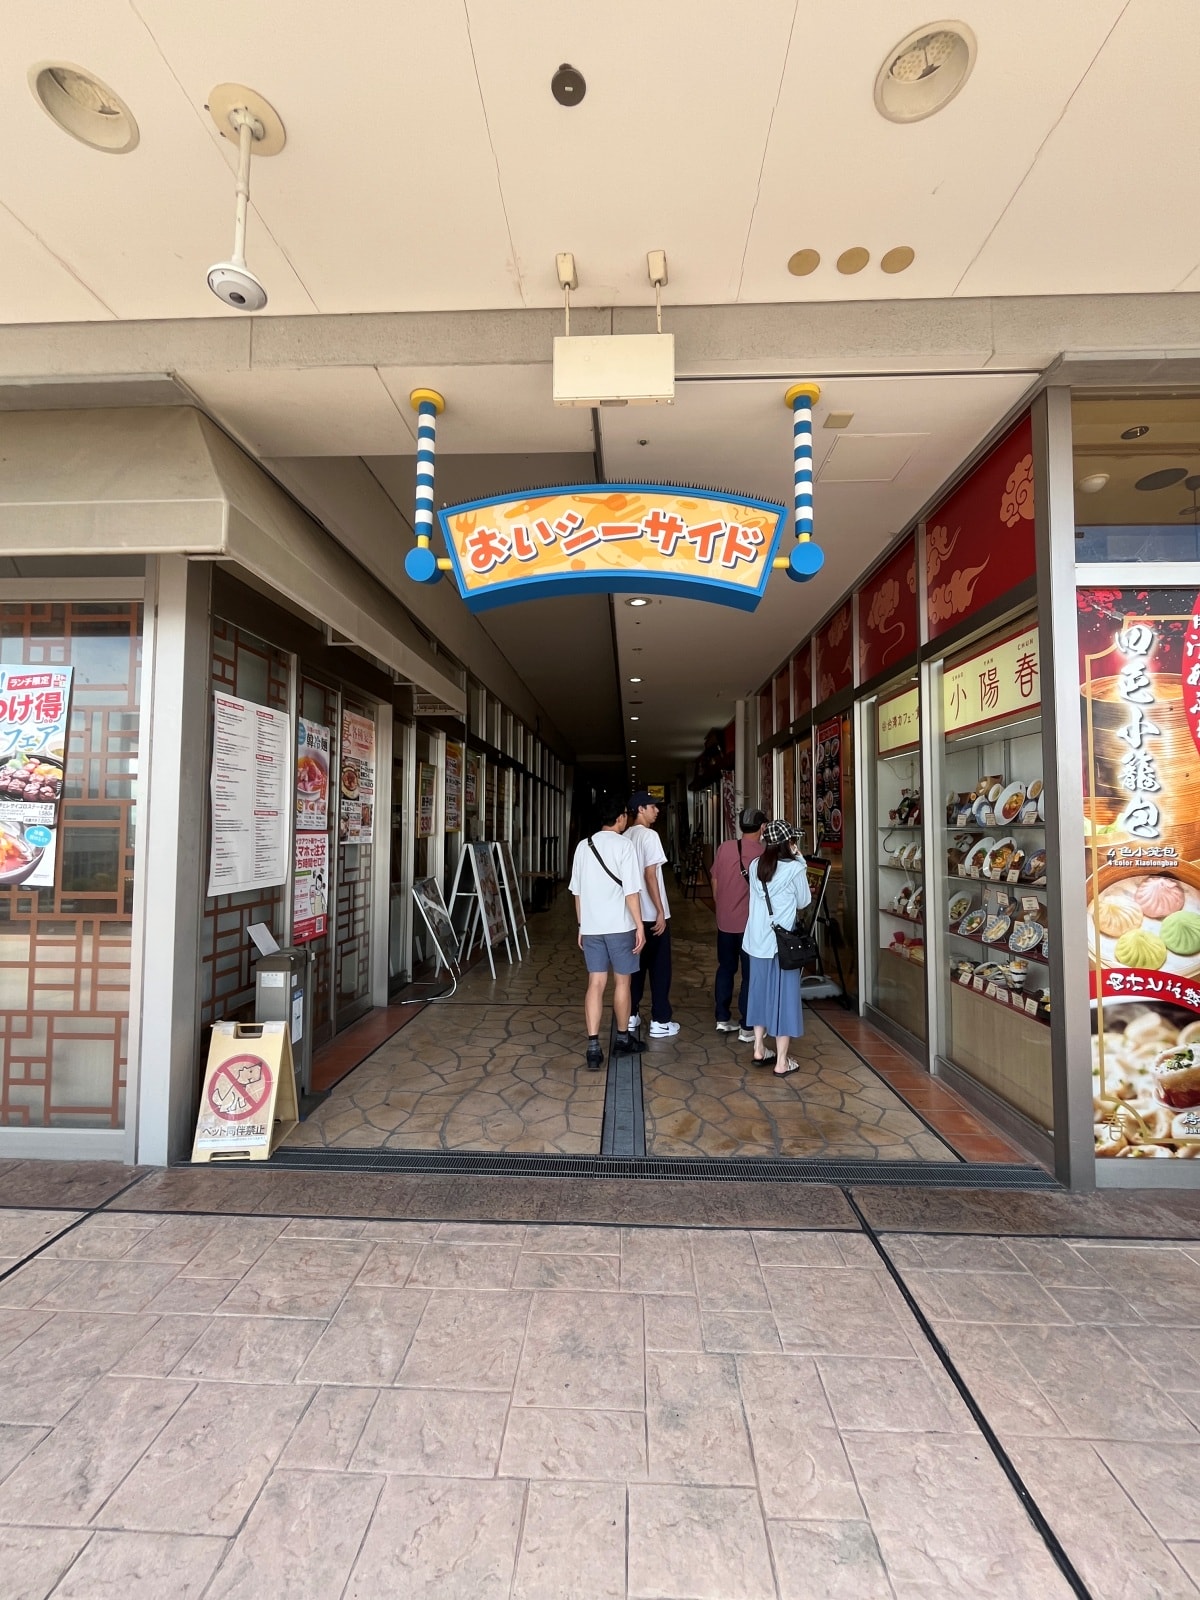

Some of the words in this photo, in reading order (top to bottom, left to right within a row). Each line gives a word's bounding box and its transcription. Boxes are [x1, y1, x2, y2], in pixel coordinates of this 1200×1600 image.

[466, 508, 765, 573] おいシーサイド
[1017, 638, 1034, 650] CHUN
[950, 652, 1039, 721] 小陽春
[3, 725, 60, 751] フェア
[296, 844, 326, 857] マホで注文
[1135, 860, 1178, 868] Xiaolongbao
[202, 1125, 265, 1137] ペット同伴禁止
